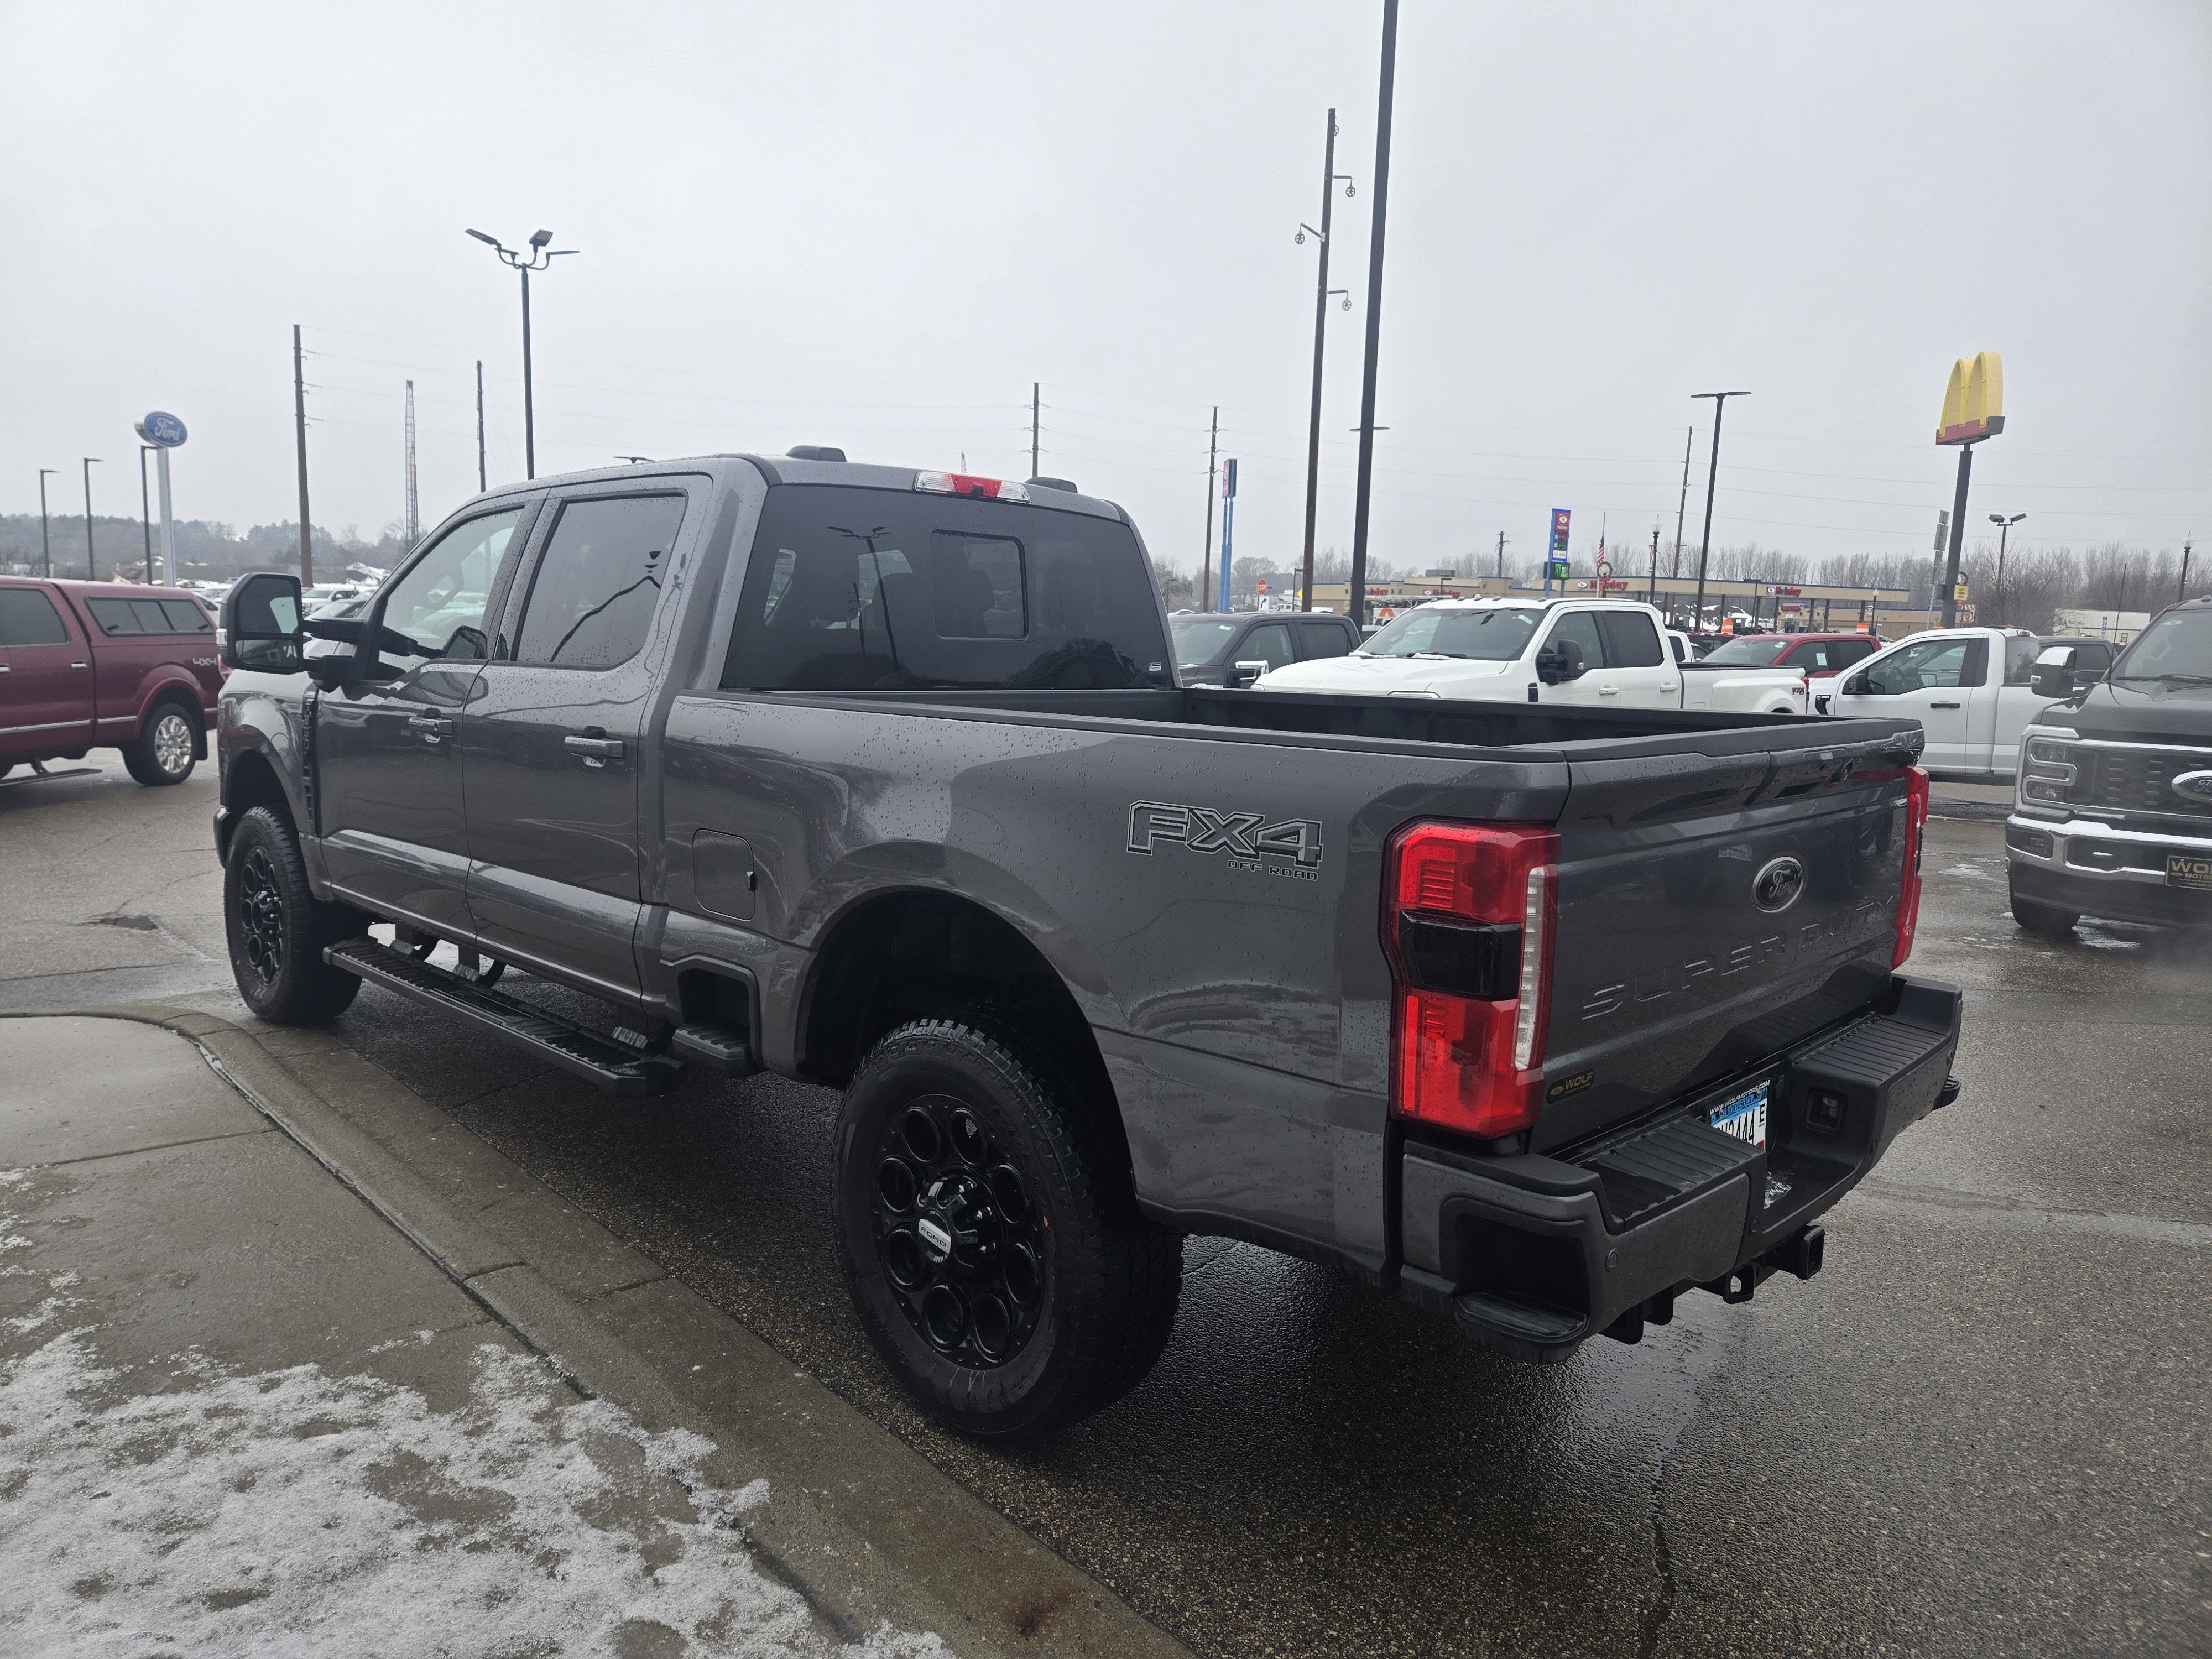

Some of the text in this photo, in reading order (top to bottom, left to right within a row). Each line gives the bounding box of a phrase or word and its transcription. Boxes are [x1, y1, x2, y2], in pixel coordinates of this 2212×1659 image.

[155, 417, 180, 441] Ford
[1775, 586, 1802, 598] Holiday
[1126, 800, 1324, 870] FX4
[1227, 859, 1319, 881] OFF ROAD
[2171, 860, 2212, 874] WO
[1769, 869, 1797, 899] Ford
[1582, 932, 1786, 1020] SUPER
[1565, 1072, 1593, 1089] WOLF
[1724, 1095, 1751, 1117] innesota
[921, 1226, 946, 1248] FORD
